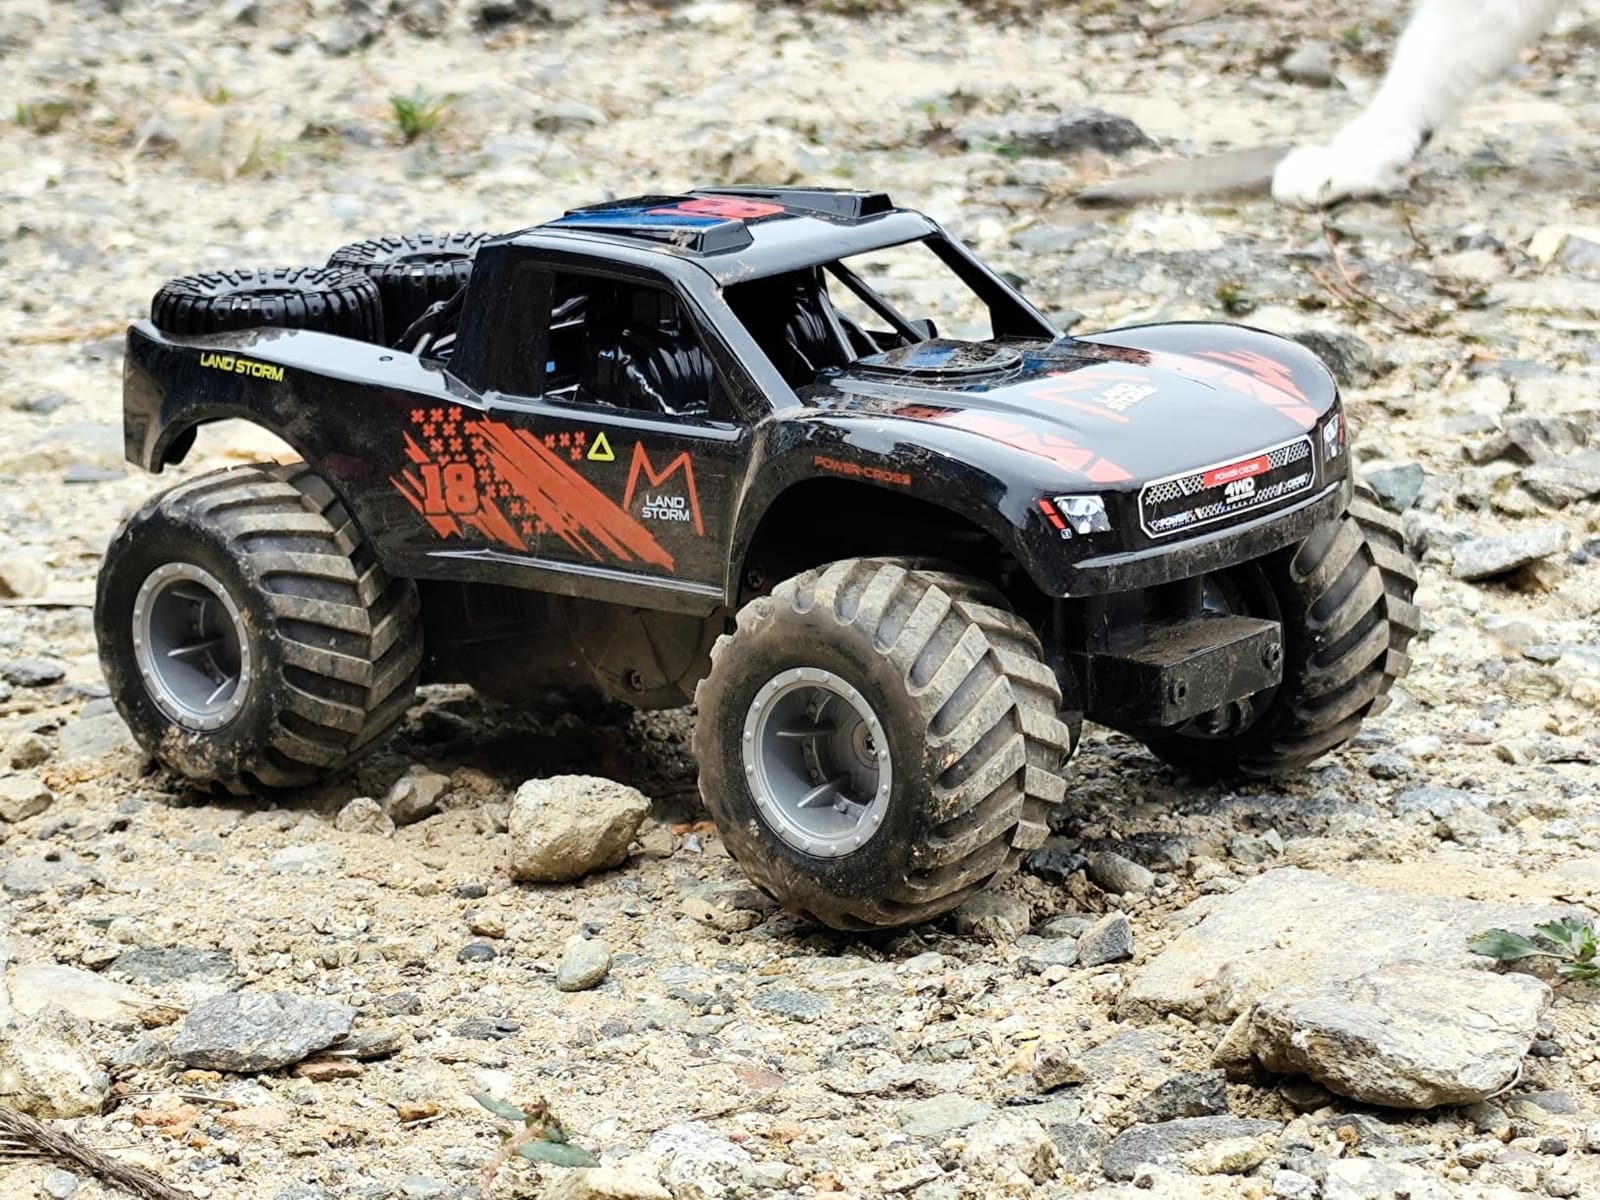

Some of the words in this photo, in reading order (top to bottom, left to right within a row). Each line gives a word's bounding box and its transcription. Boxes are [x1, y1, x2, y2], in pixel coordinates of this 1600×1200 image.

[200, 352, 236, 371] LAND
[236, 360, 284, 382] STORM
[814, 455, 911, 486] POWER-CROSS
[420, 462, 480, 516] 18
[1224, 477, 1256, 497] 4WD
[641, 506, 690, 522] STORM
[645, 494, 685, 509] LAND
